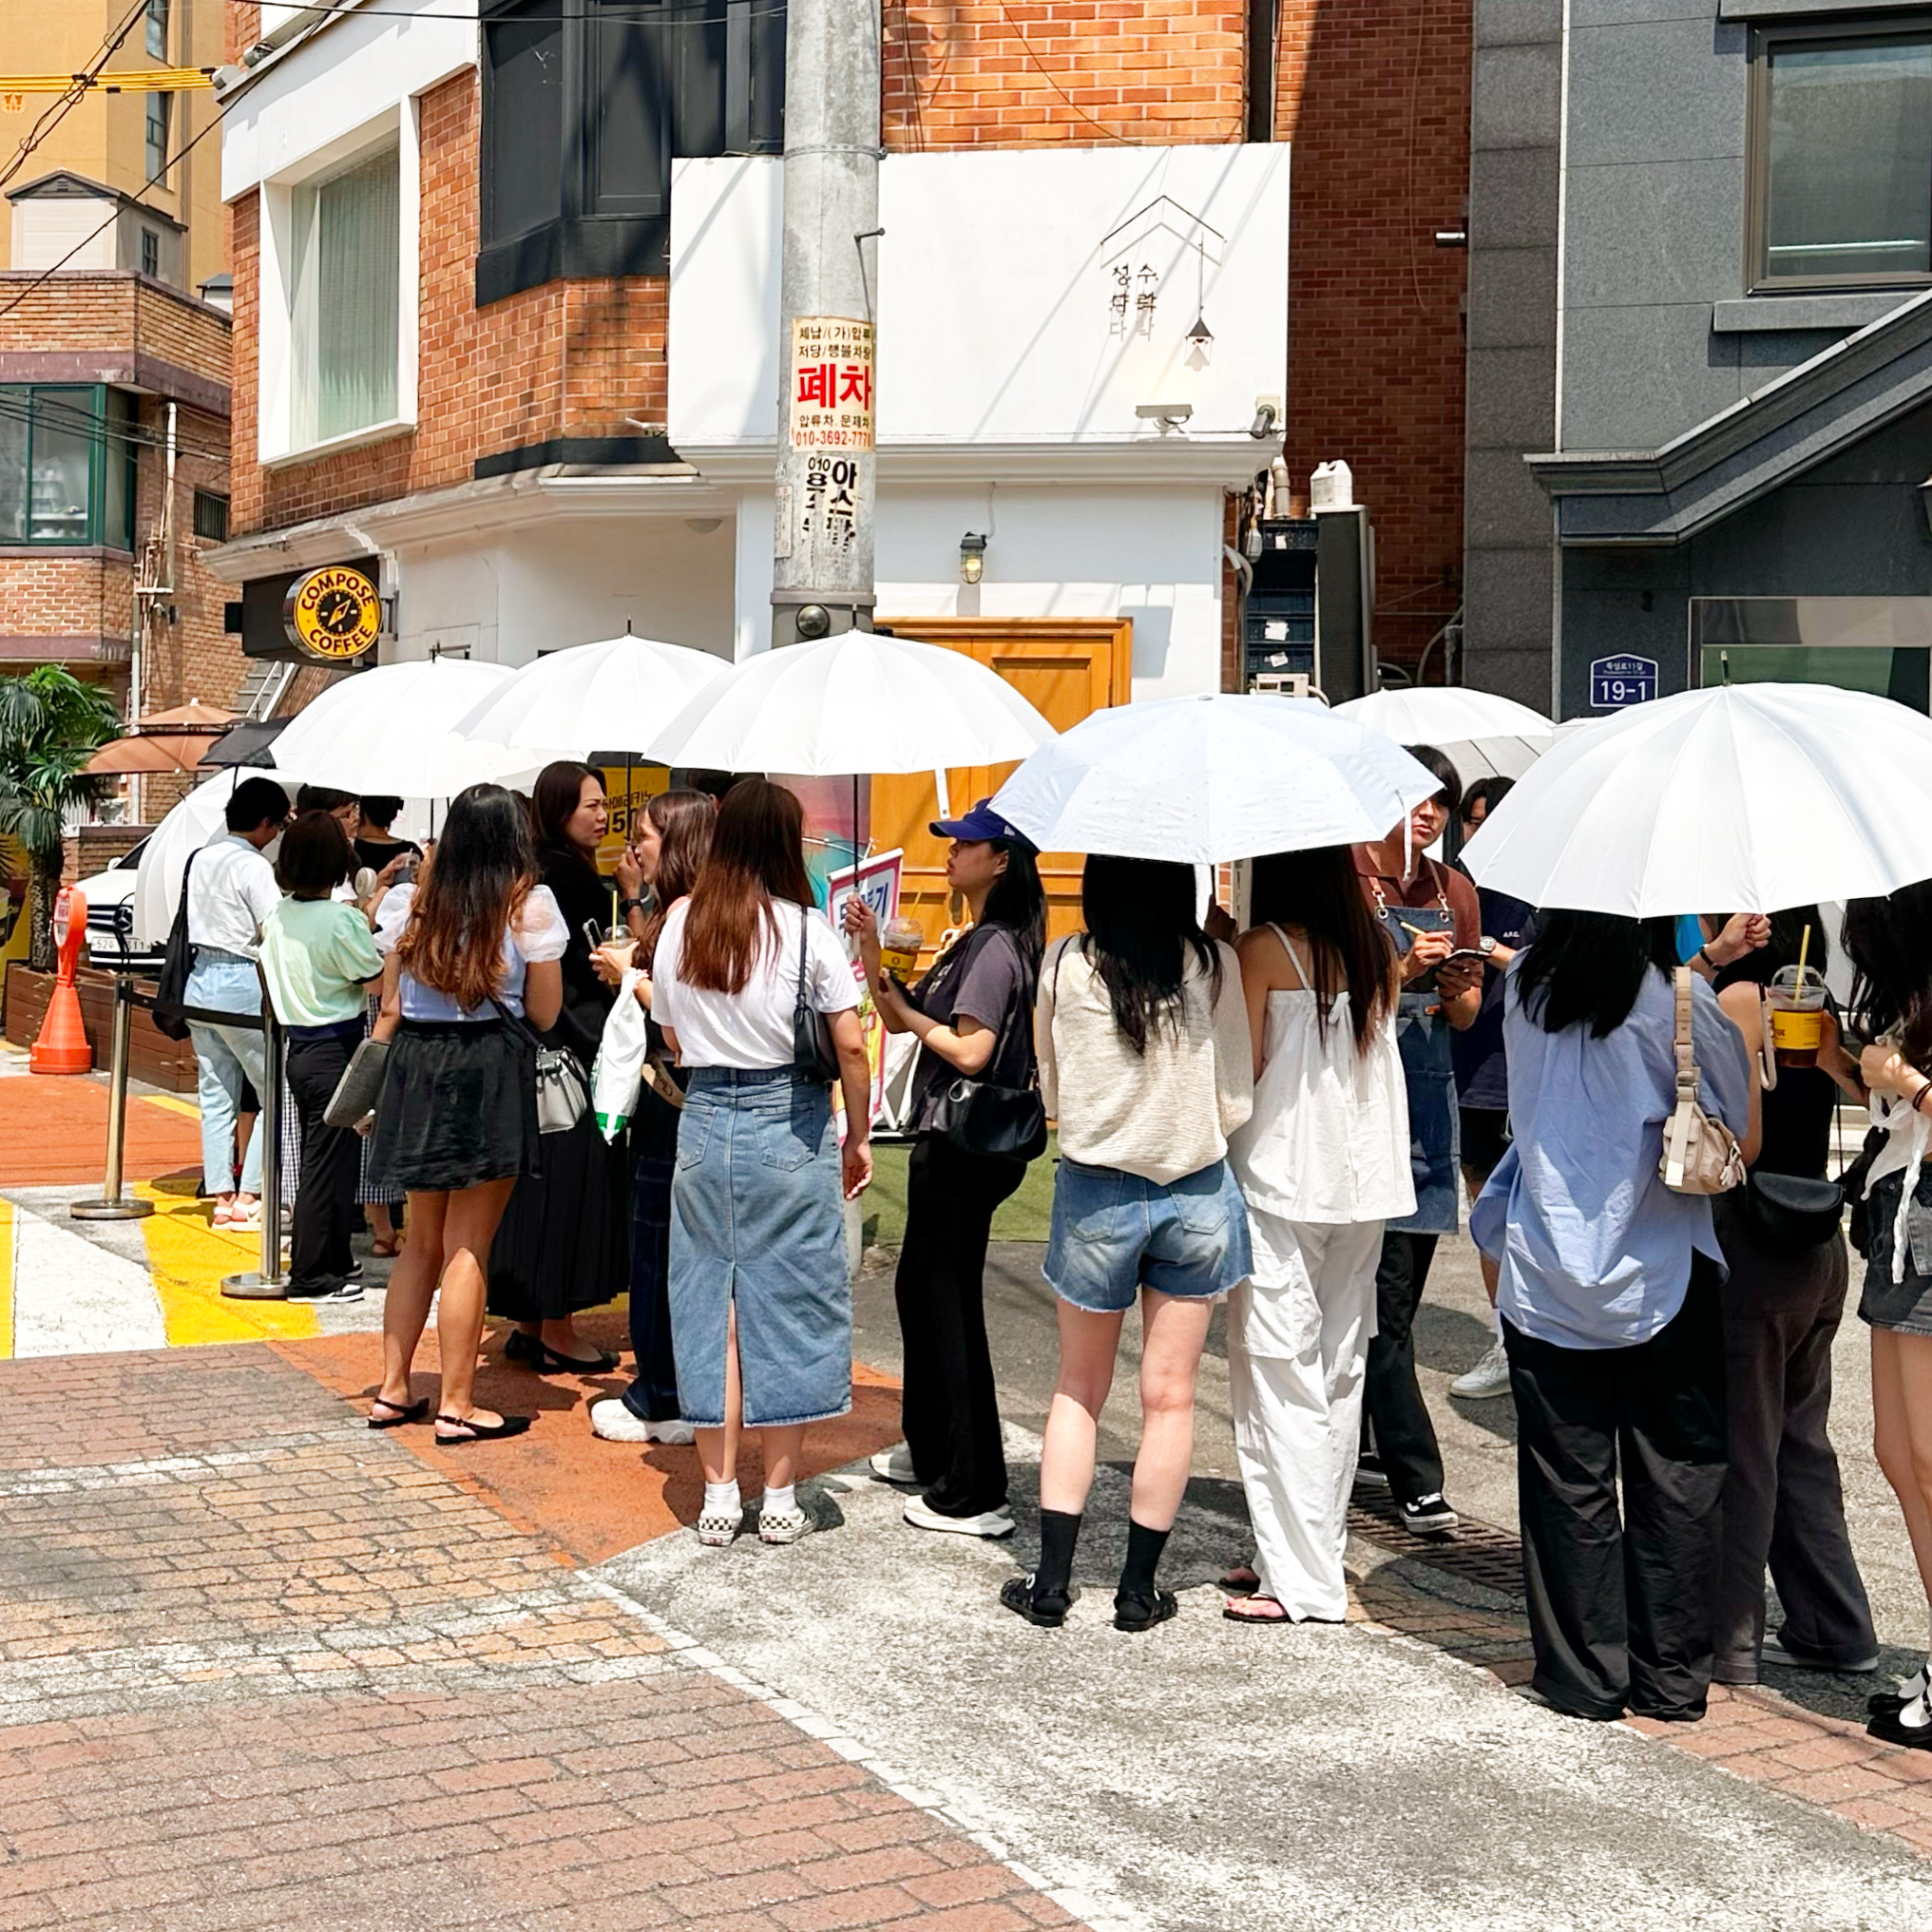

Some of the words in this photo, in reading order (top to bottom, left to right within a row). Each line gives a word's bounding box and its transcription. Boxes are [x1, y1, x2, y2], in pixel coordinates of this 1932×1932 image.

[1112, 262, 1157, 287] 성수
[797, 363, 871, 411] 폐차
[808, 457, 831, 472] 010
[301, 573, 376, 610] COMPOSE
[310, 625, 373, 653] COFFEE
[1600, 680, 1645, 701] 19-1
